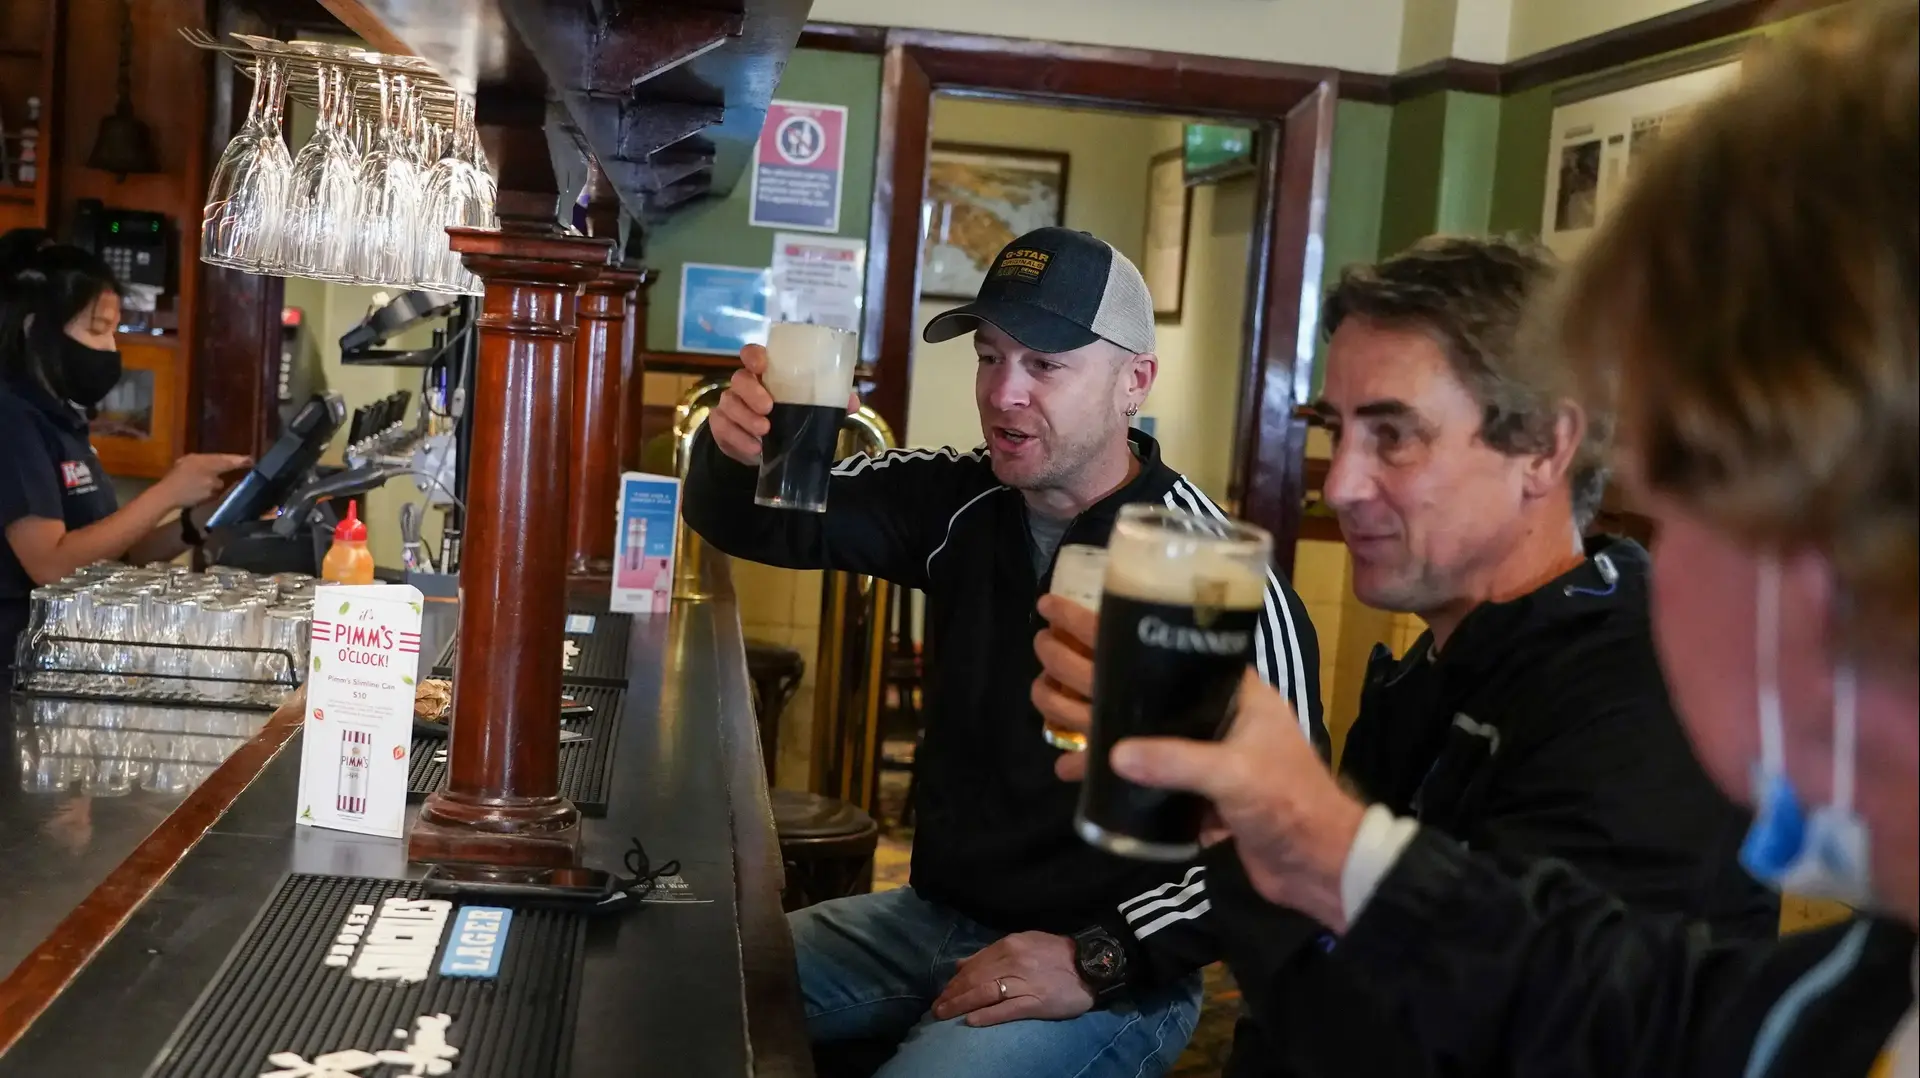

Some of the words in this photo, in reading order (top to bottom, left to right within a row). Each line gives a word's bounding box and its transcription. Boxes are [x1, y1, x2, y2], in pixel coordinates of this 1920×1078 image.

[1006, 250, 1049, 262] G-STAR
[1002, 259, 1043, 270] ORIGINALS
[335, 624, 394, 650] PIMM'S
[338, 647, 389, 668] O'CLOCK!
[327, 674, 351, 685] Pimm's
[353, 678, 380, 689] Slimline
[381, 682, 396, 691] Can
[353, 691, 367, 700] $10
[341, 755, 369, 769] PIMM'S
[451, 910, 504, 971] LAGER
